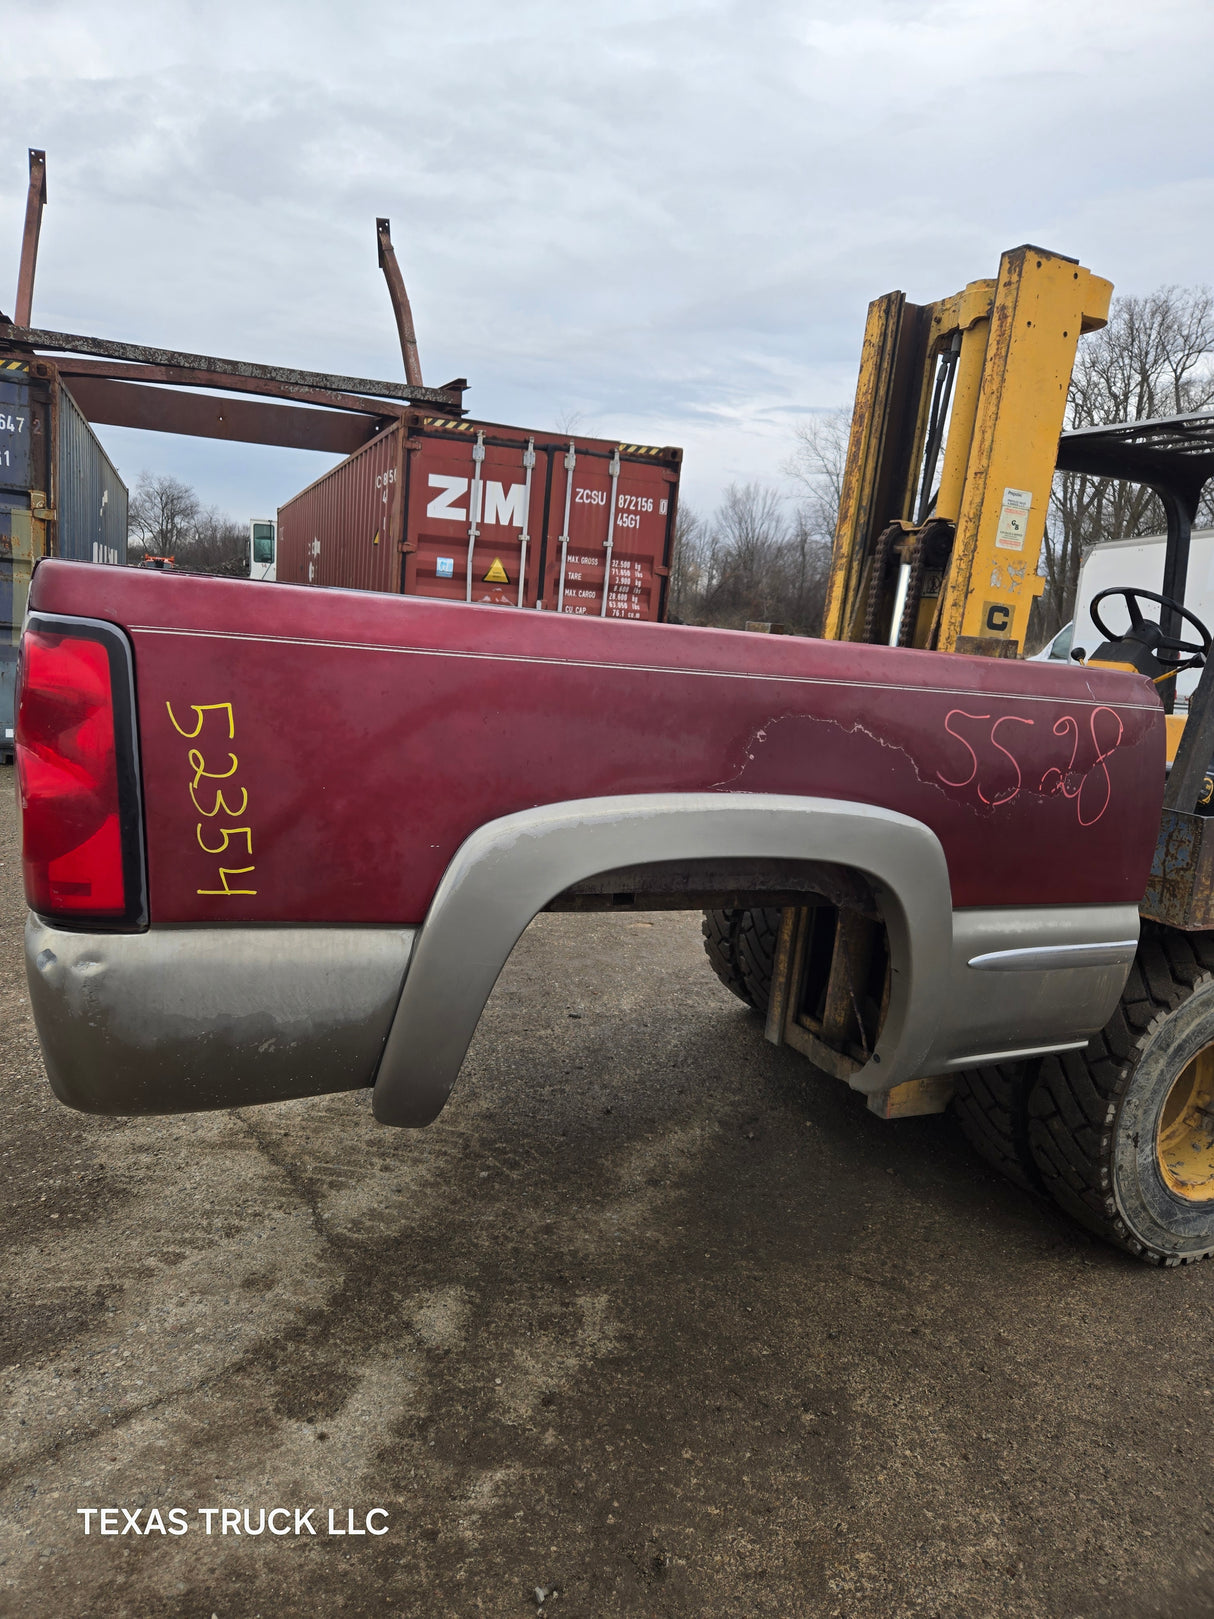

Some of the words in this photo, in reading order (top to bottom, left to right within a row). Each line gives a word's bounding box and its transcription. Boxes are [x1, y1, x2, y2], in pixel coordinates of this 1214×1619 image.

[426, 473, 528, 527] ZIM
[575, 488, 607, 506] ZCSU
[618, 495, 653, 512] 872156
[616, 512, 641, 529] 45G1
[580, 556, 599, 566] GROSS
[568, 572, 582, 581] TARE
[578, 590, 596, 599] CARGO
[986, 605, 1010, 632] C
[166, 701, 258, 895] 52354
